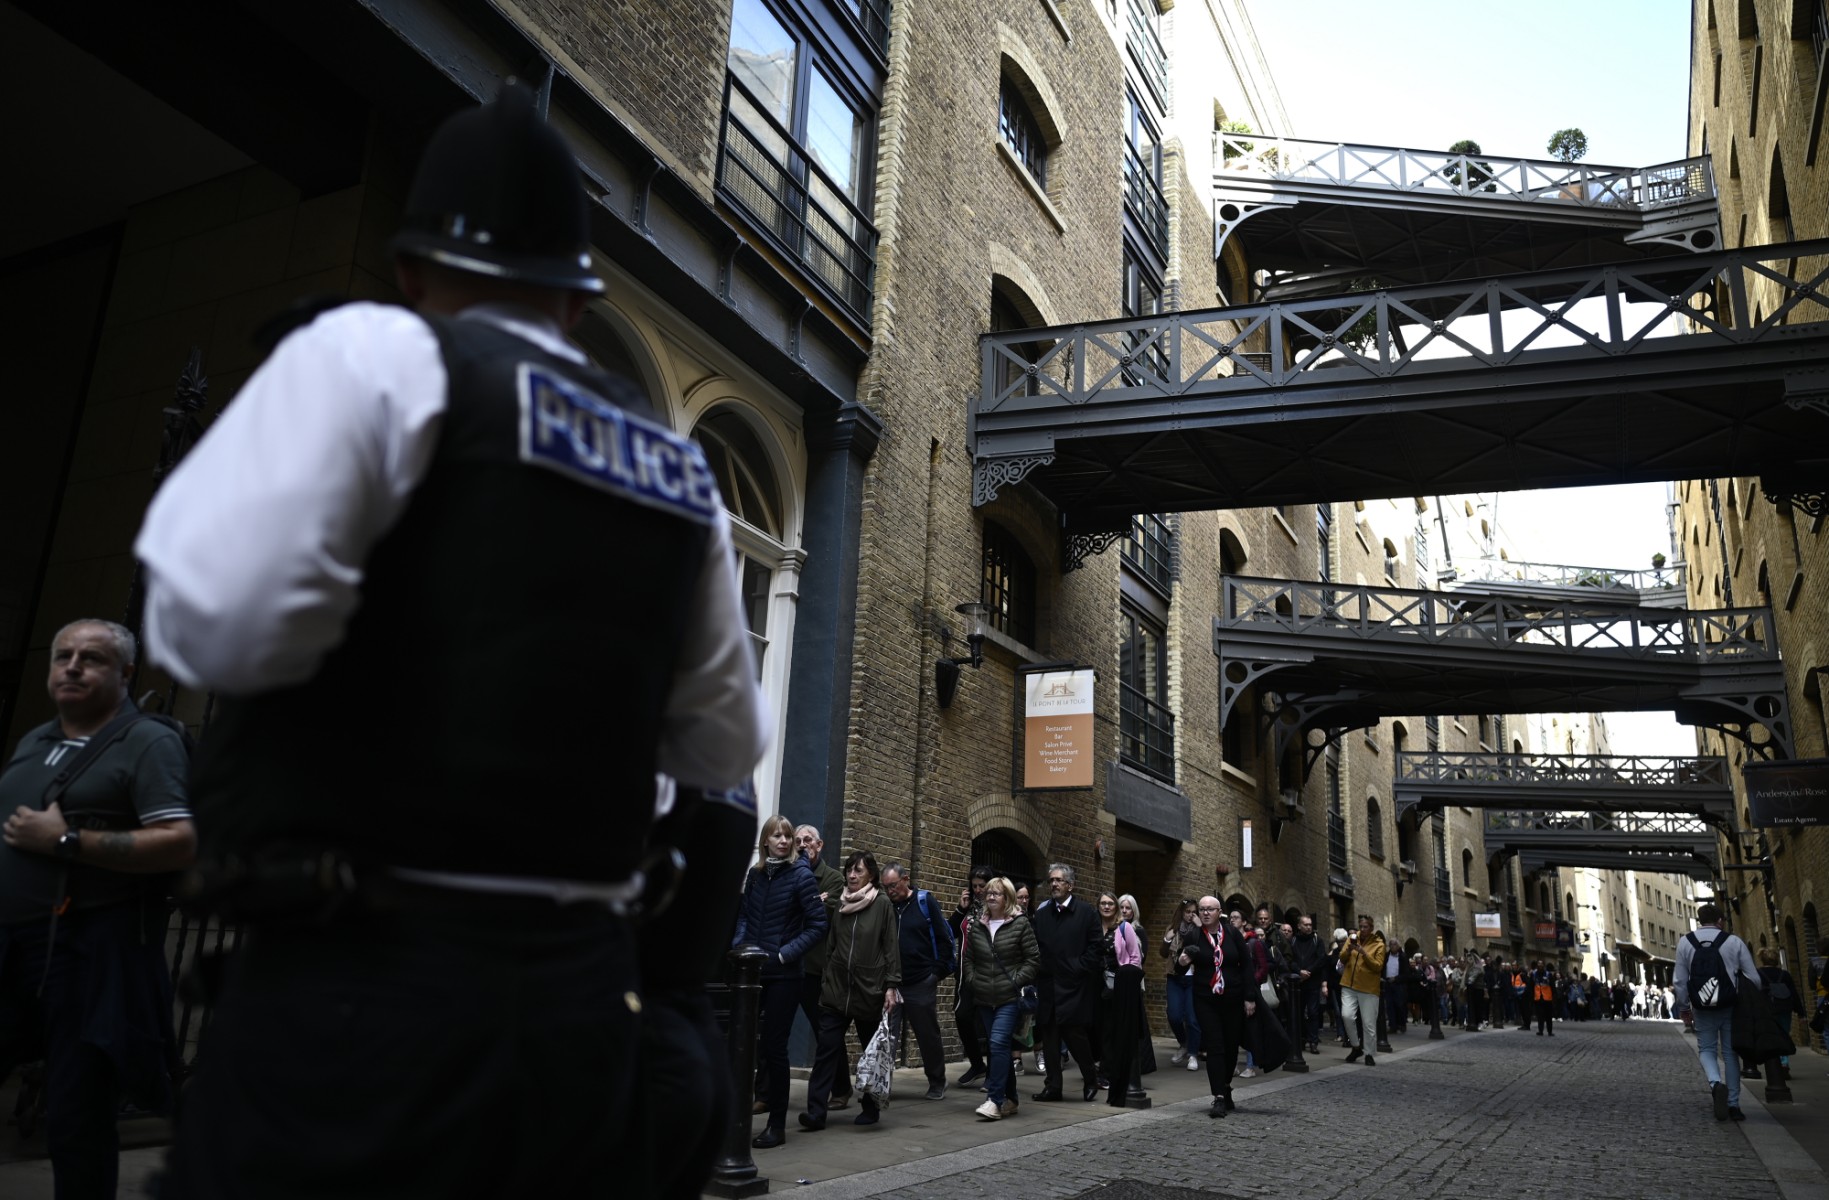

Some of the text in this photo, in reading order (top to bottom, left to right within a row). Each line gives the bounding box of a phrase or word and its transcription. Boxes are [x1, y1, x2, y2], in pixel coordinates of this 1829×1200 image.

[534, 382, 714, 509] POLICE
[1054, 748, 1078, 756] Merchant
[1049, 765, 1067, 773] Bakery
[1755, 788, 1799, 799] Anderson
[1805, 787, 1828, 796] Rose
[1795, 816, 1818, 825] Agents
[1698, 976, 1718, 1004] NIKE
